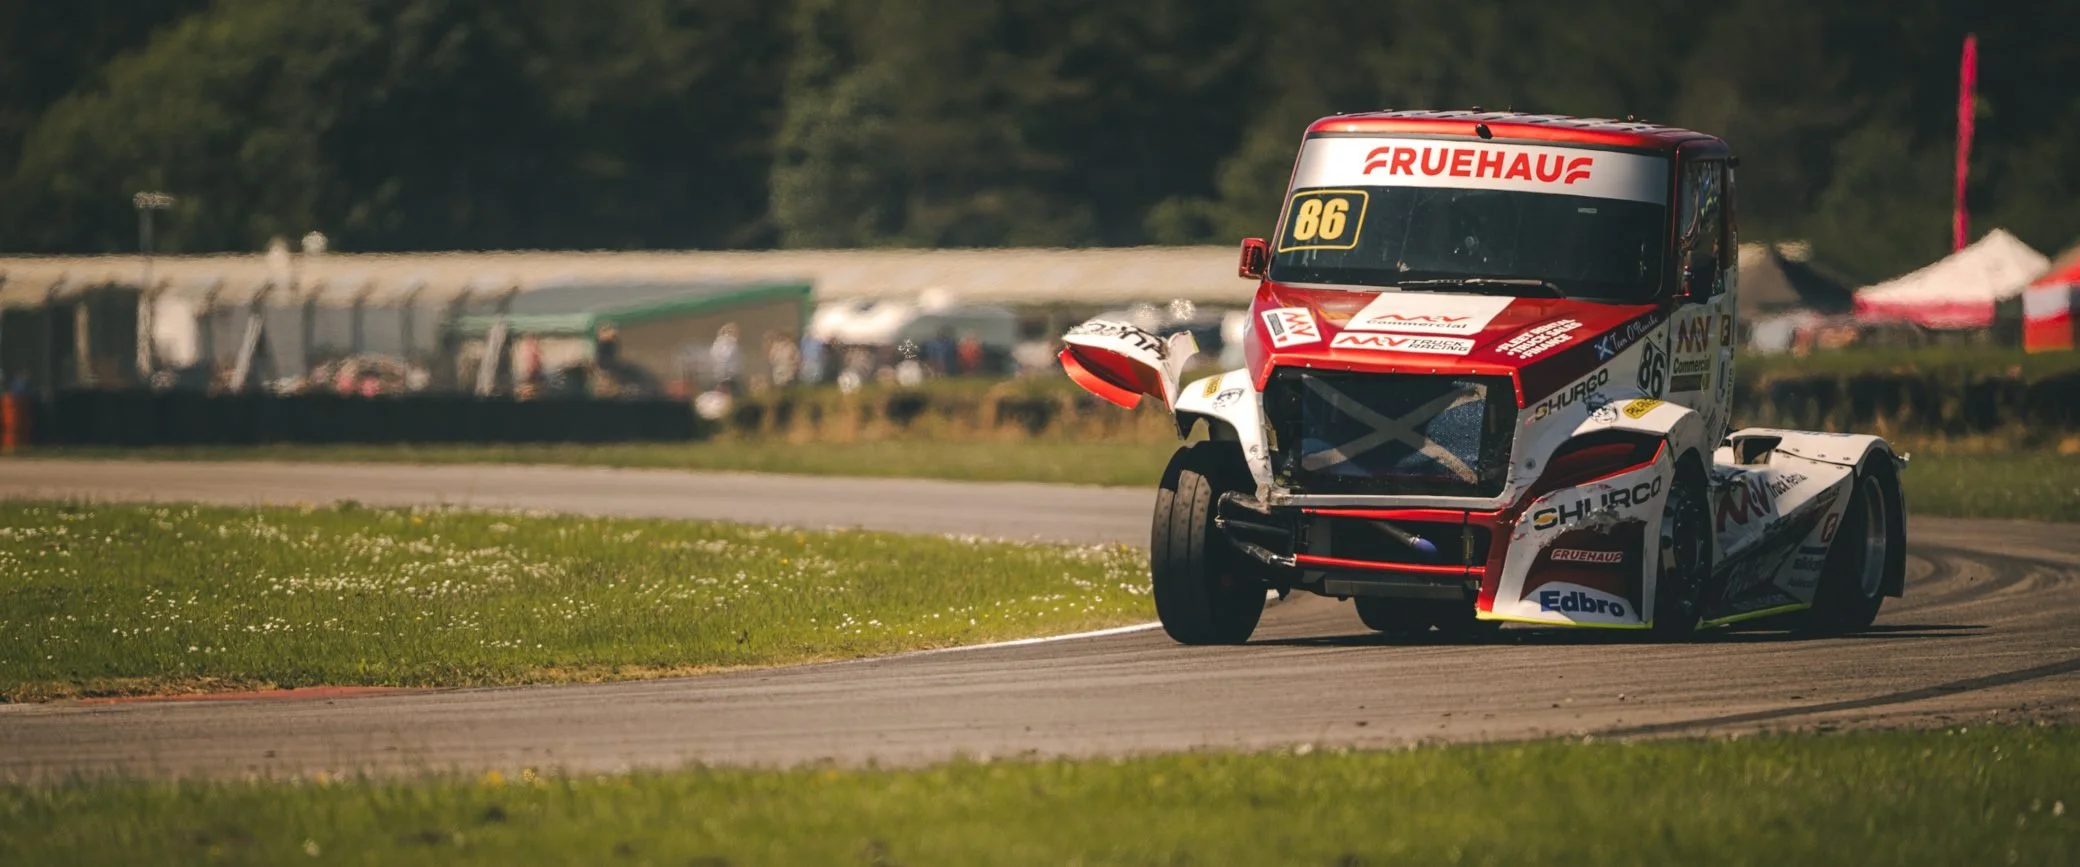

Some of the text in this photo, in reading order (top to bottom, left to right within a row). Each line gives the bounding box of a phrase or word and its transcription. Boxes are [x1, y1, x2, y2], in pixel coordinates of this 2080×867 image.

[1363, 146, 1593, 185] FRUEHAUF
[1294, 198, 1349, 241] 86
[1366, 319, 1467, 329] Commercial
[1408, 343, 1469, 352] RACING
[1411, 338, 1466, 347] TRUCK
[1498, 332, 1534, 351] FLEET
[1511, 322, 1583, 353] TRUCK SALES
[1522, 333, 1573, 358] FINANCE
[1638, 342, 1665, 399] 86
[1673, 354, 1711, 374] Commercial
[1533, 475, 1661, 531] SHURCO
[1552, 549, 1623, 563] FRUEHAUF
[1540, 590, 1625, 617] Edbro
